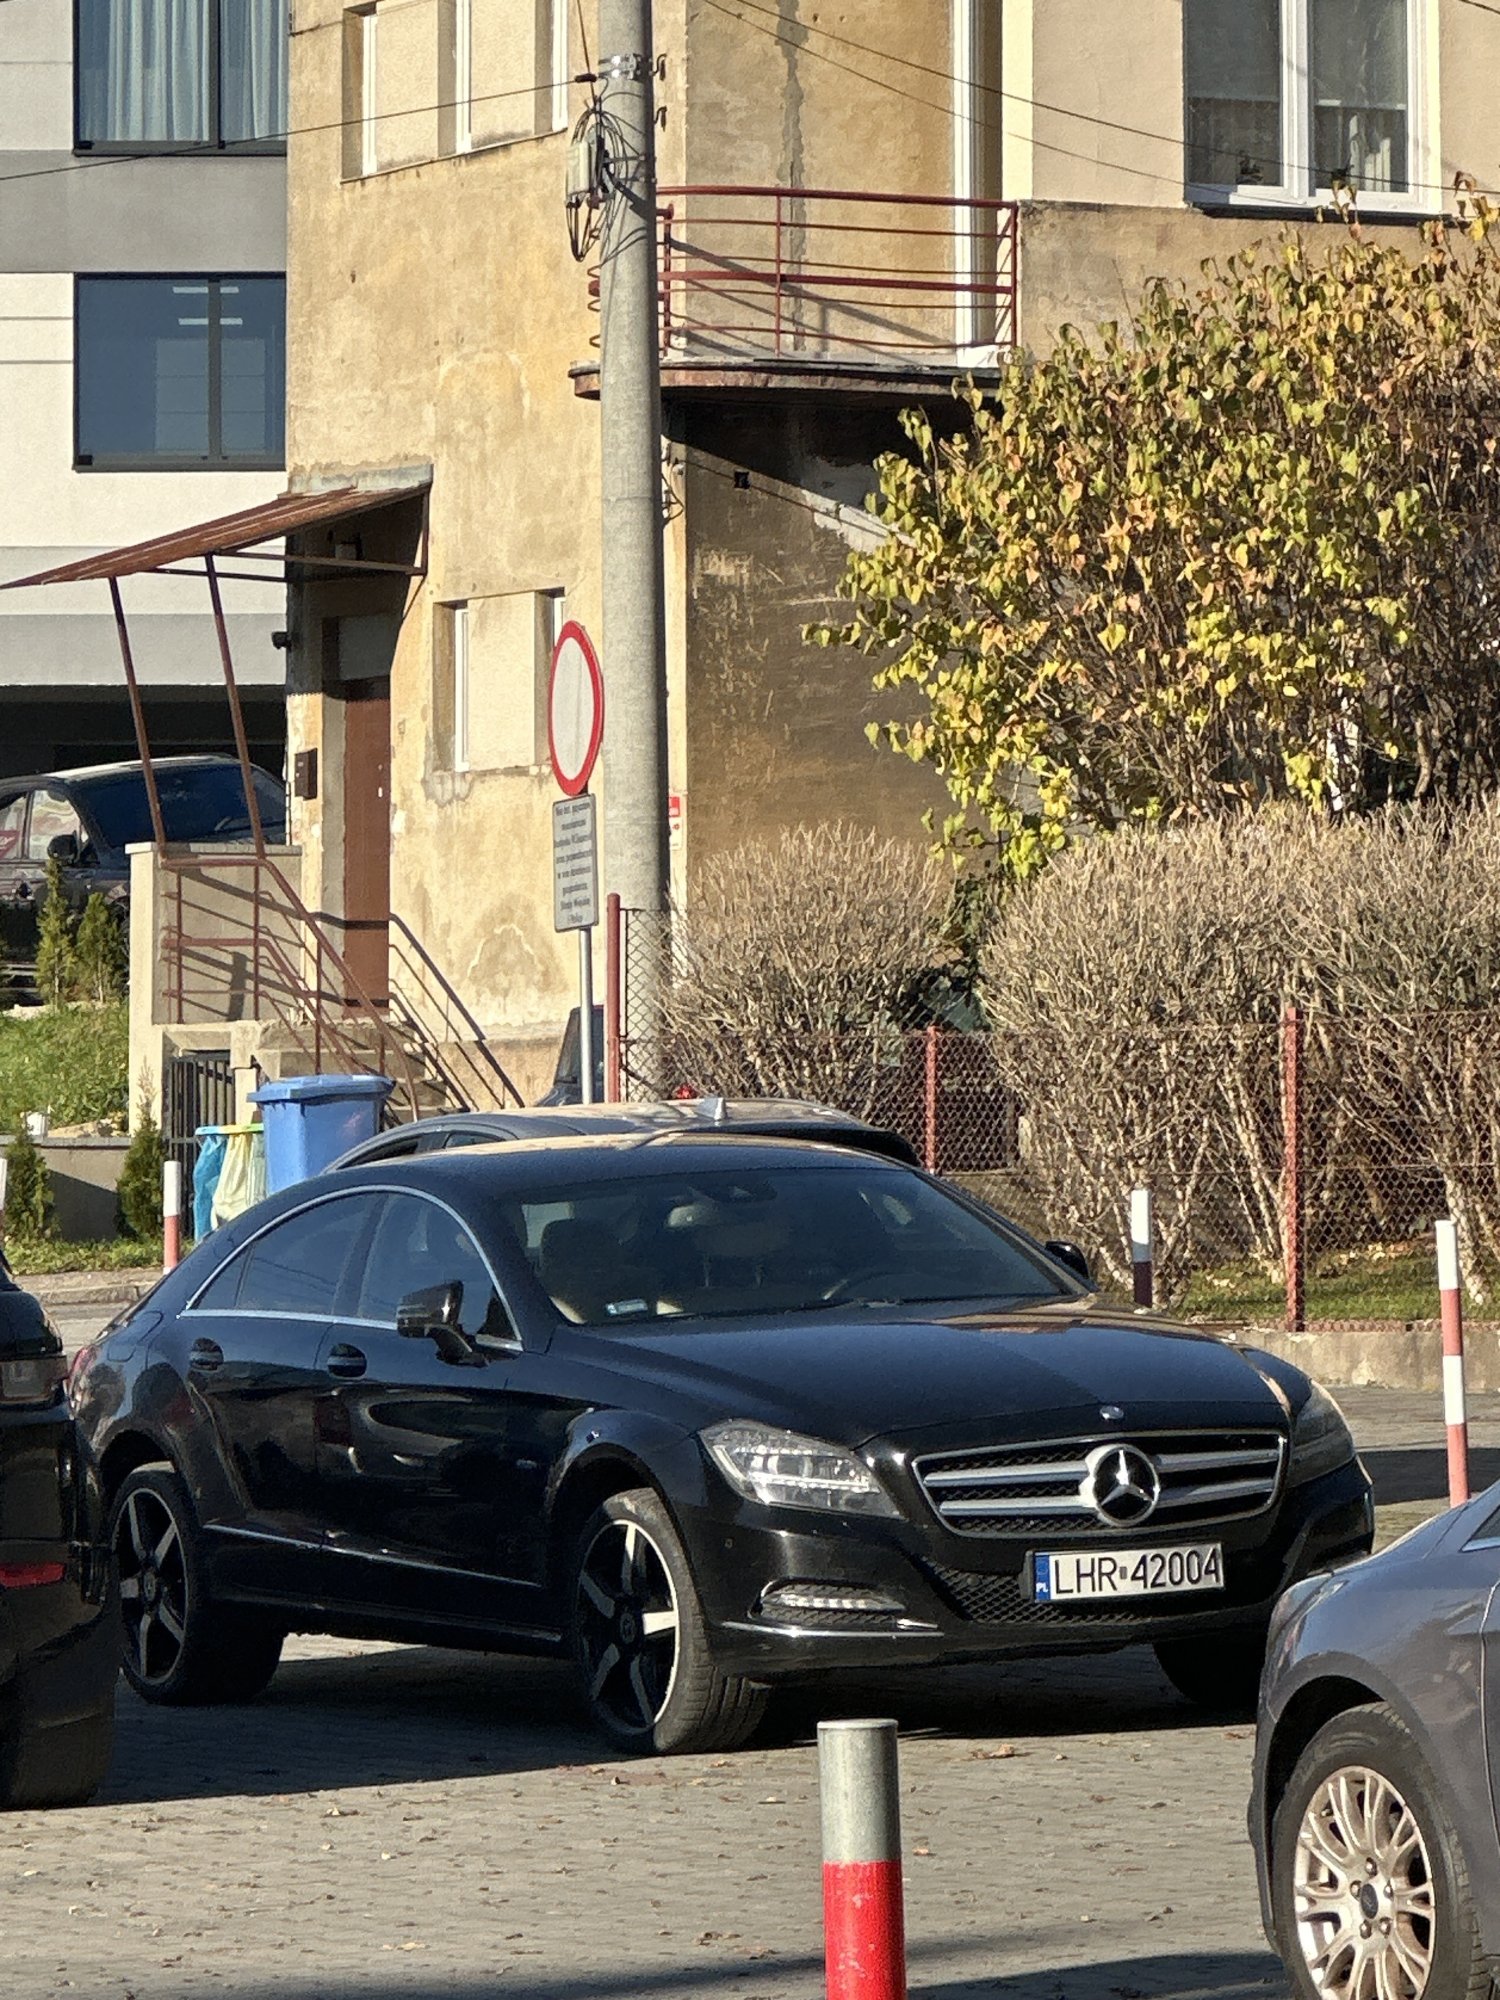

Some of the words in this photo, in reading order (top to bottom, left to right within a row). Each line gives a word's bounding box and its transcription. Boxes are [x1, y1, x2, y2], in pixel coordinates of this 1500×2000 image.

[1054, 1557, 1118, 1594] LHR
[1130, 1547, 1221, 1590] 42004
[1036, 1582, 1048, 1593] PL
